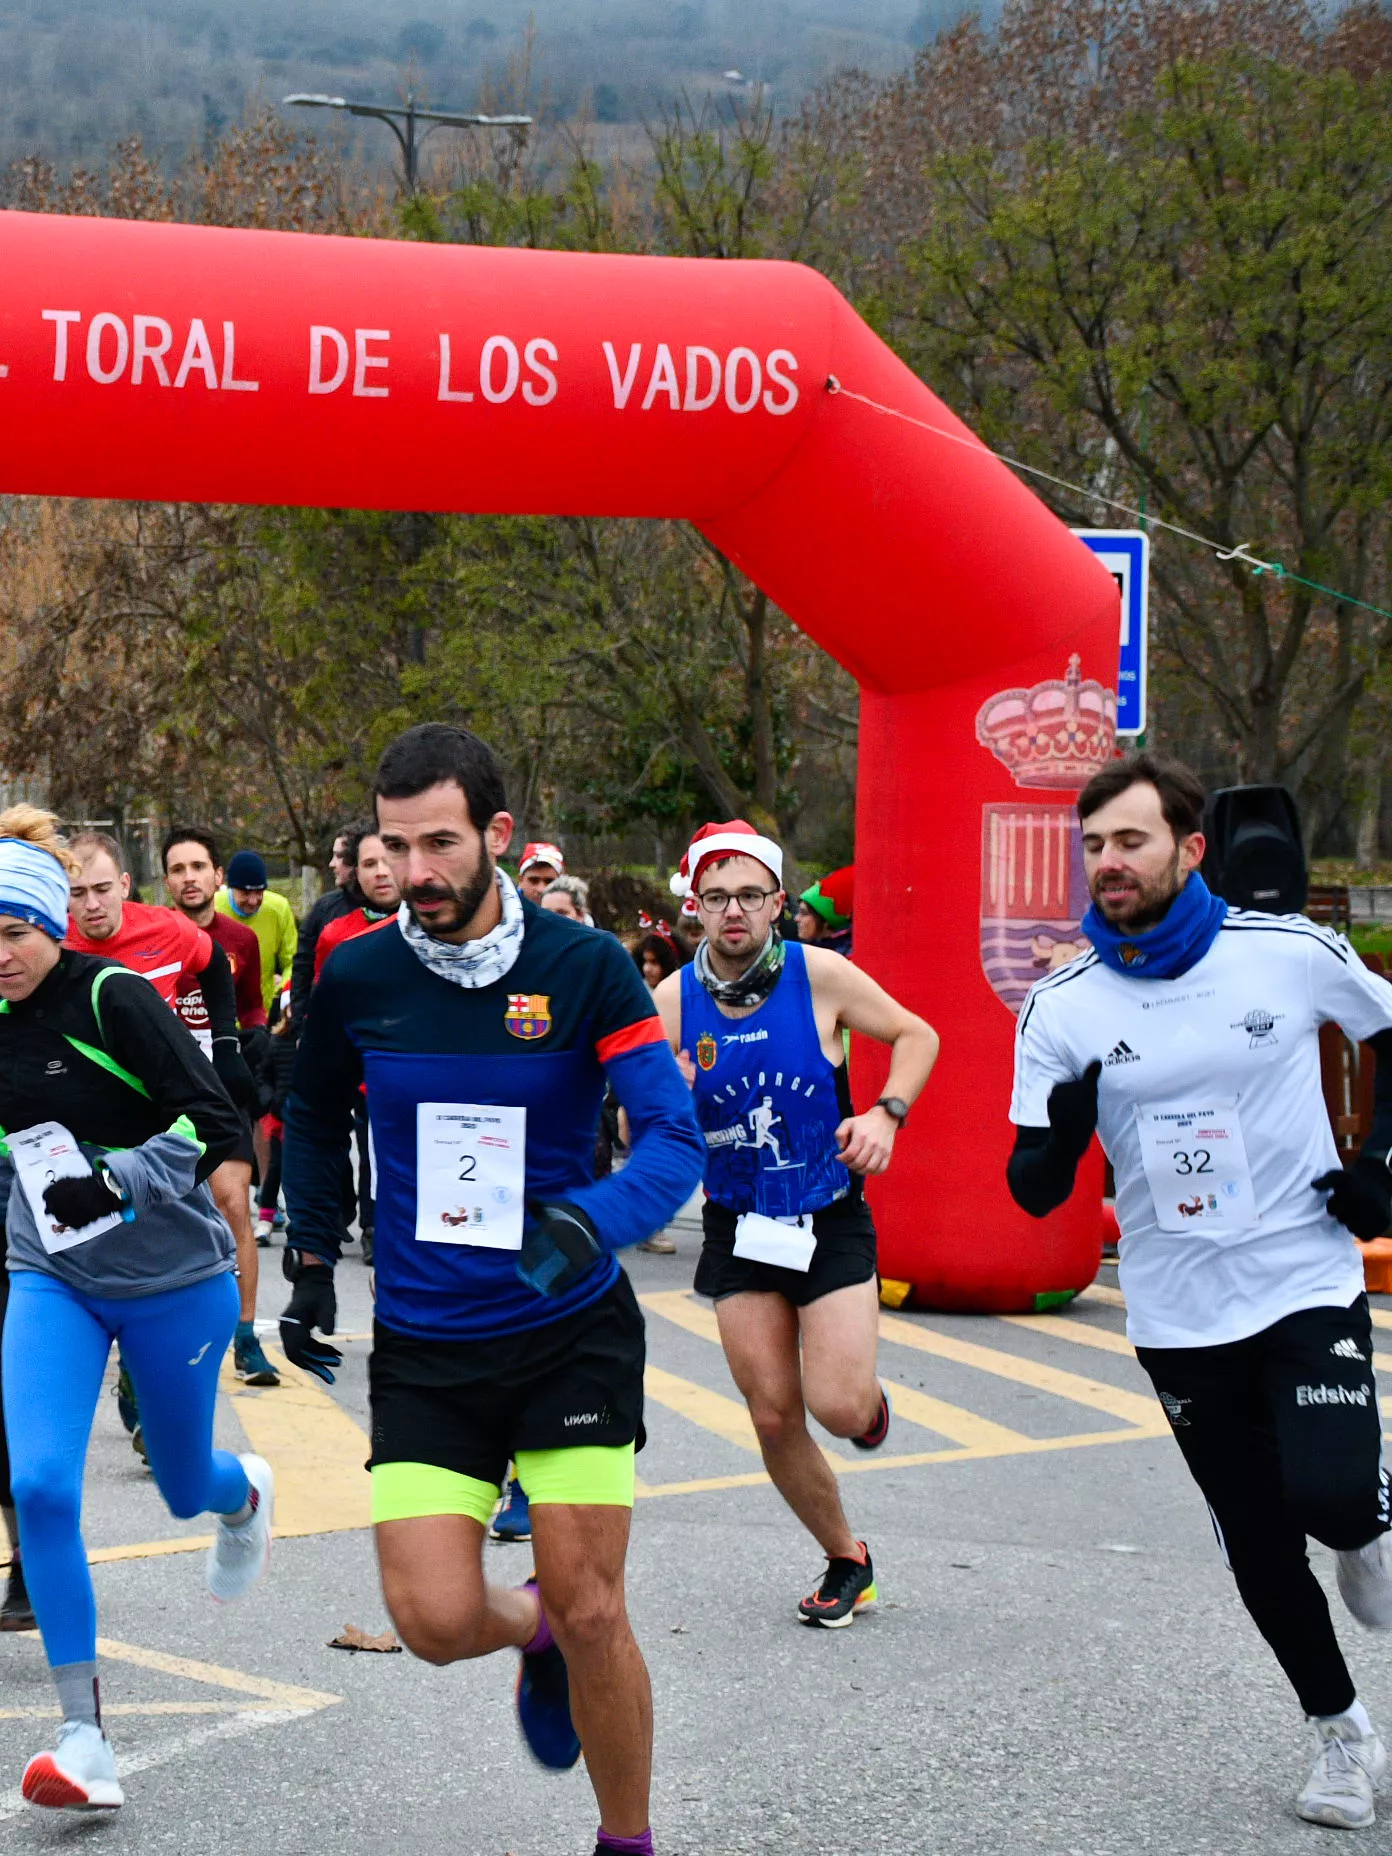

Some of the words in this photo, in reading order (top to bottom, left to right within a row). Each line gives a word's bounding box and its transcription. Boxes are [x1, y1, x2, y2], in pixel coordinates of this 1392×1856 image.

[41, 308, 259, 391] TORAL
[309, 325, 391, 397] DE
[437, 333, 559, 406] LOS
[601, 341, 799, 416] VADOS
[175, 996, 203, 1006] capi
[1104, 1053, 1141, 1067] adidas
[712, 1071, 815, 1105] ASTORGA
[458, 1155, 476, 1181] 2
[1173, 1149, 1214, 1175] 32
